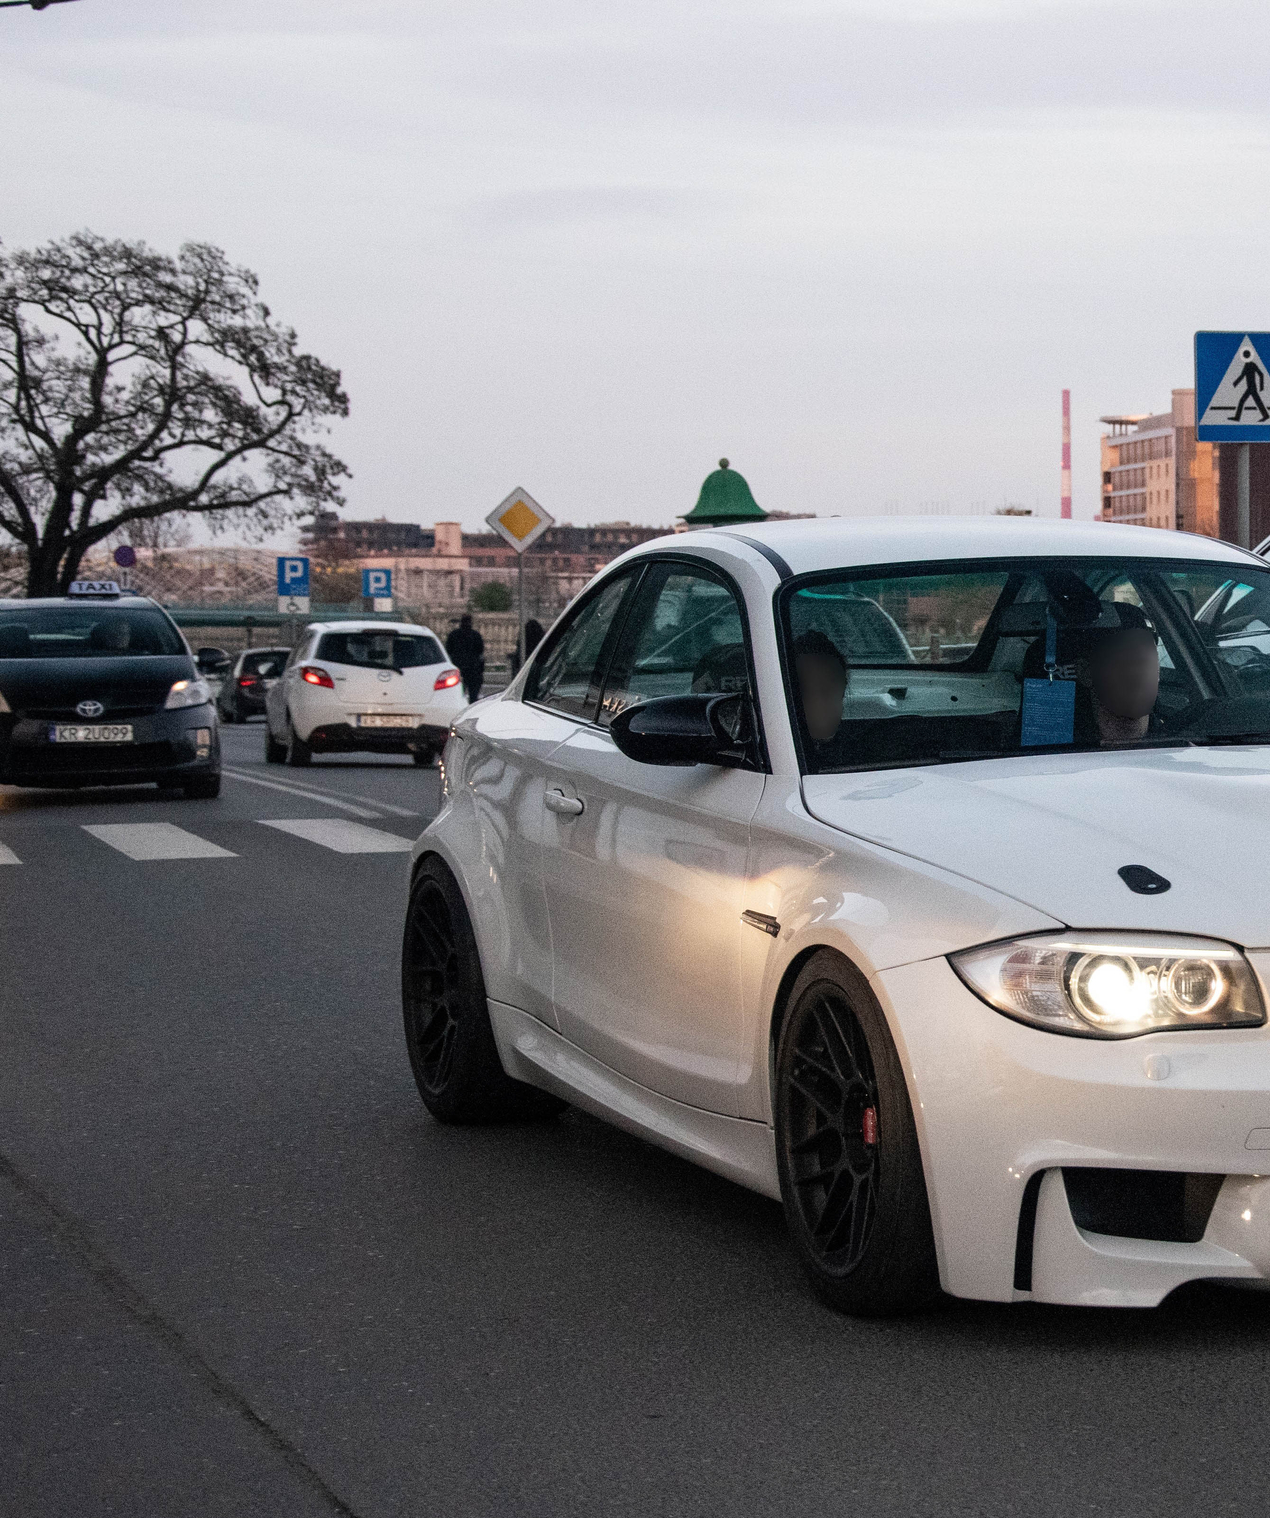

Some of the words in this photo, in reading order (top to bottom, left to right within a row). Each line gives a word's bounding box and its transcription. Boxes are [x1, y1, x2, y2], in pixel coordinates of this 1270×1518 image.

[284, 559, 304, 584] P
[76, 582, 113, 591] TAXI
[368, 571, 387, 594] P
[58, 727, 78, 741] KR
